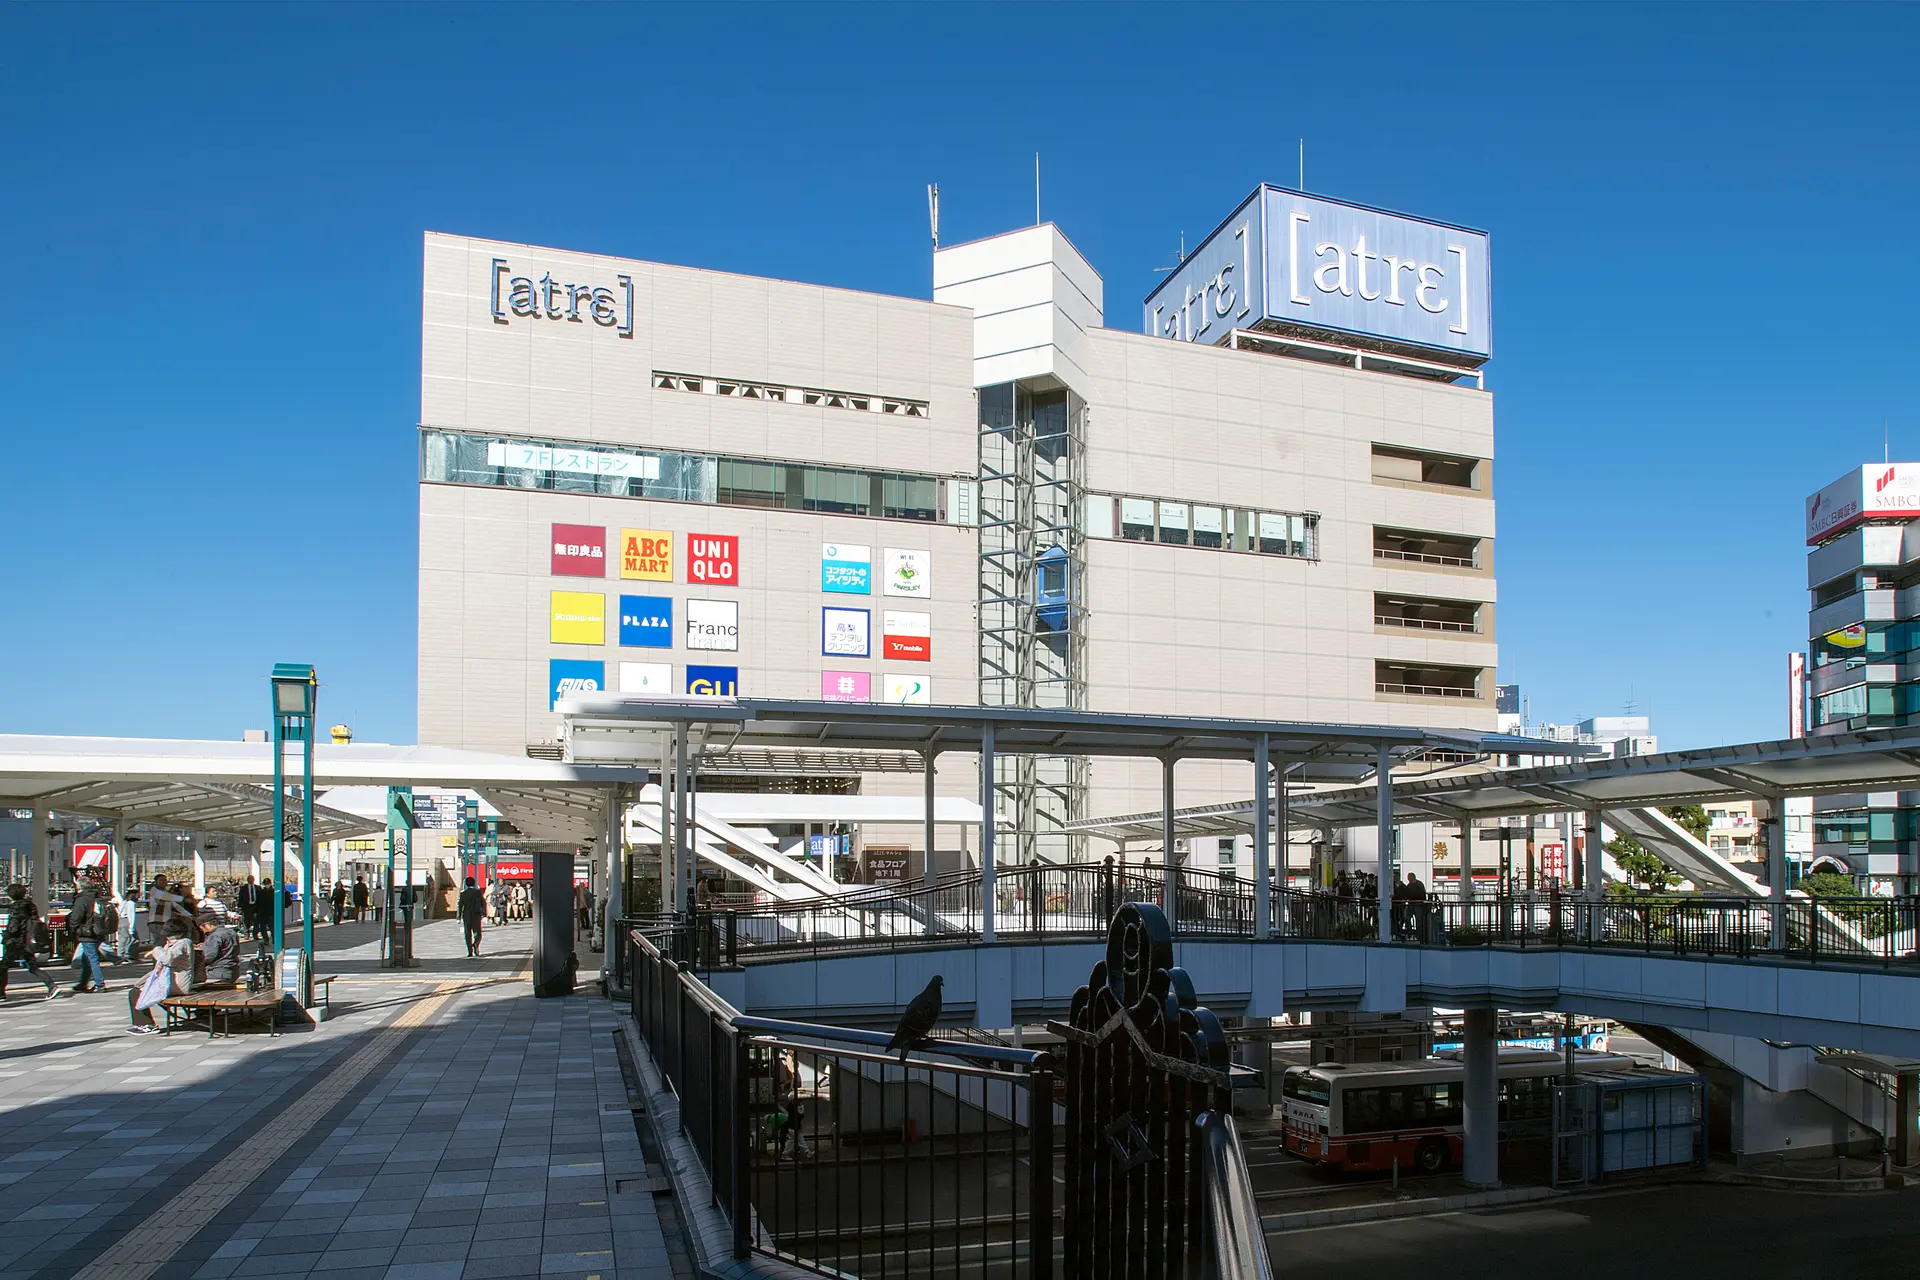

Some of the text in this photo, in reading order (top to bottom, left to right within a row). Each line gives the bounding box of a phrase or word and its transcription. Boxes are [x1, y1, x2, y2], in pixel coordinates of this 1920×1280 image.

[523, 450, 629, 471] 7Fレストラン
[1875, 495, 1920, 507] SMBC
[554, 543, 603, 558] 無印良品
[625, 537, 668, 558] ABC
[693, 540, 729, 558] UNI
[625, 558, 668, 573] MART
[693, 560, 732, 580] QLO
[825, 566, 866, 576] コンタクトの
[825, 574, 866, 587] アイシティ
[623, 615, 669, 628] PLAZA
[687, 621, 738, 636] Franc
[830, 632, 862, 643] デンタル
[828, 642, 865, 653] クリニック
[690, 679, 735, 696] GU
[869, 860, 907, 868] 食品フロア
